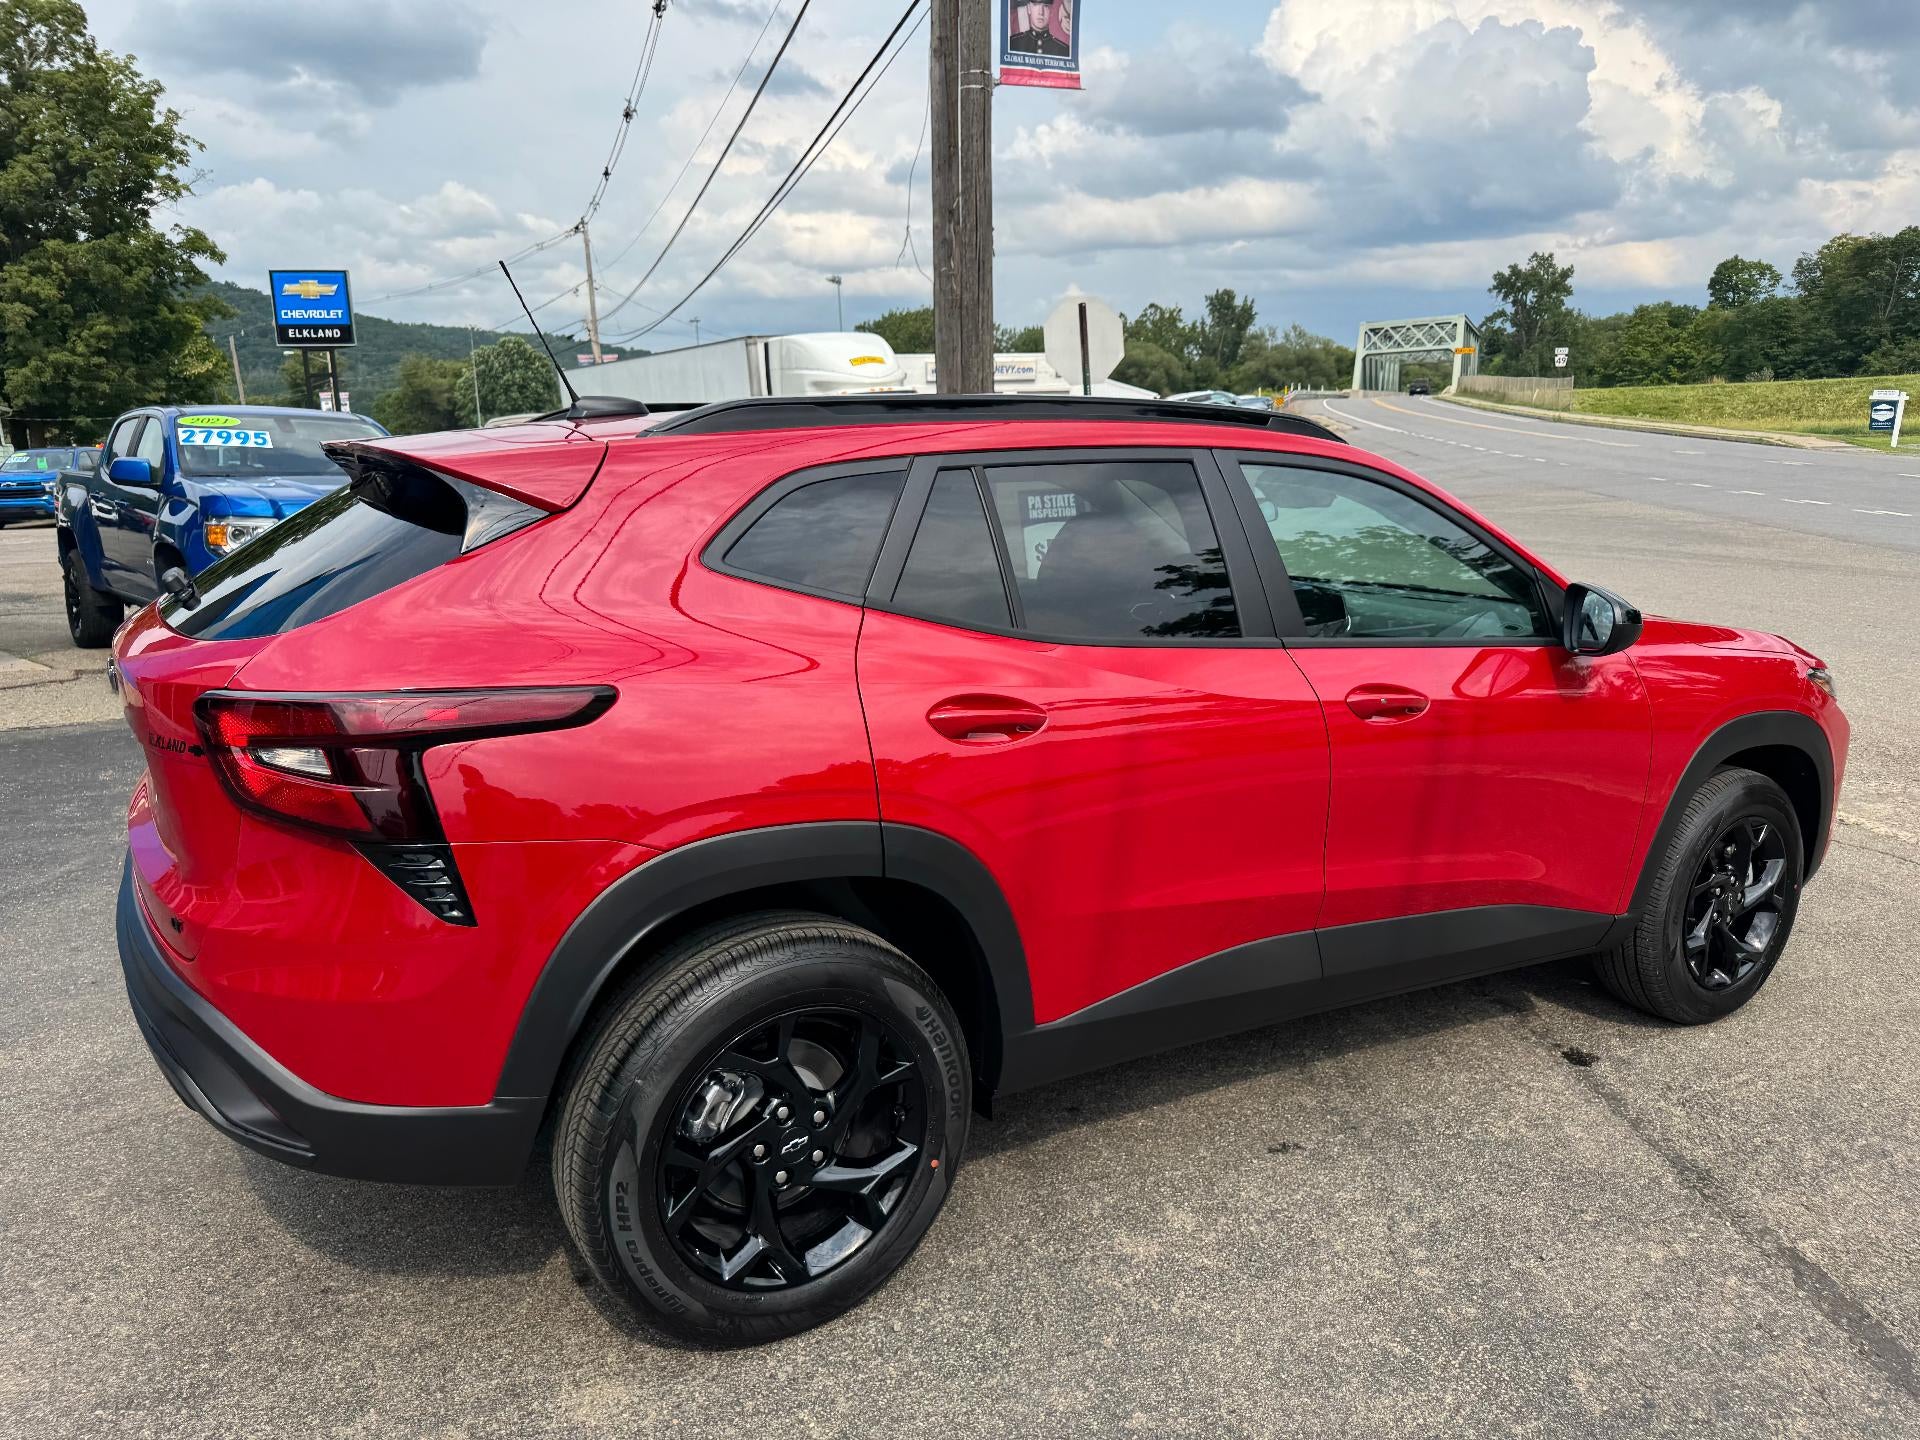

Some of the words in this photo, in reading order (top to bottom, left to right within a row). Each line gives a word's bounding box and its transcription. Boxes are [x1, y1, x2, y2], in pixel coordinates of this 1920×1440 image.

[1004, 55, 1024, 63] GLOBAL
[281, 309, 344, 319] CHEVROLET
[288, 328, 341, 338] ELKLAND
[191, 417, 229, 425] 2021
[181, 429, 268, 446] 27995
[1027, 495, 1042, 509] PA
[1044, 493, 1076, 508] STATE
[1029, 507, 1077, 519] INSPECTION
